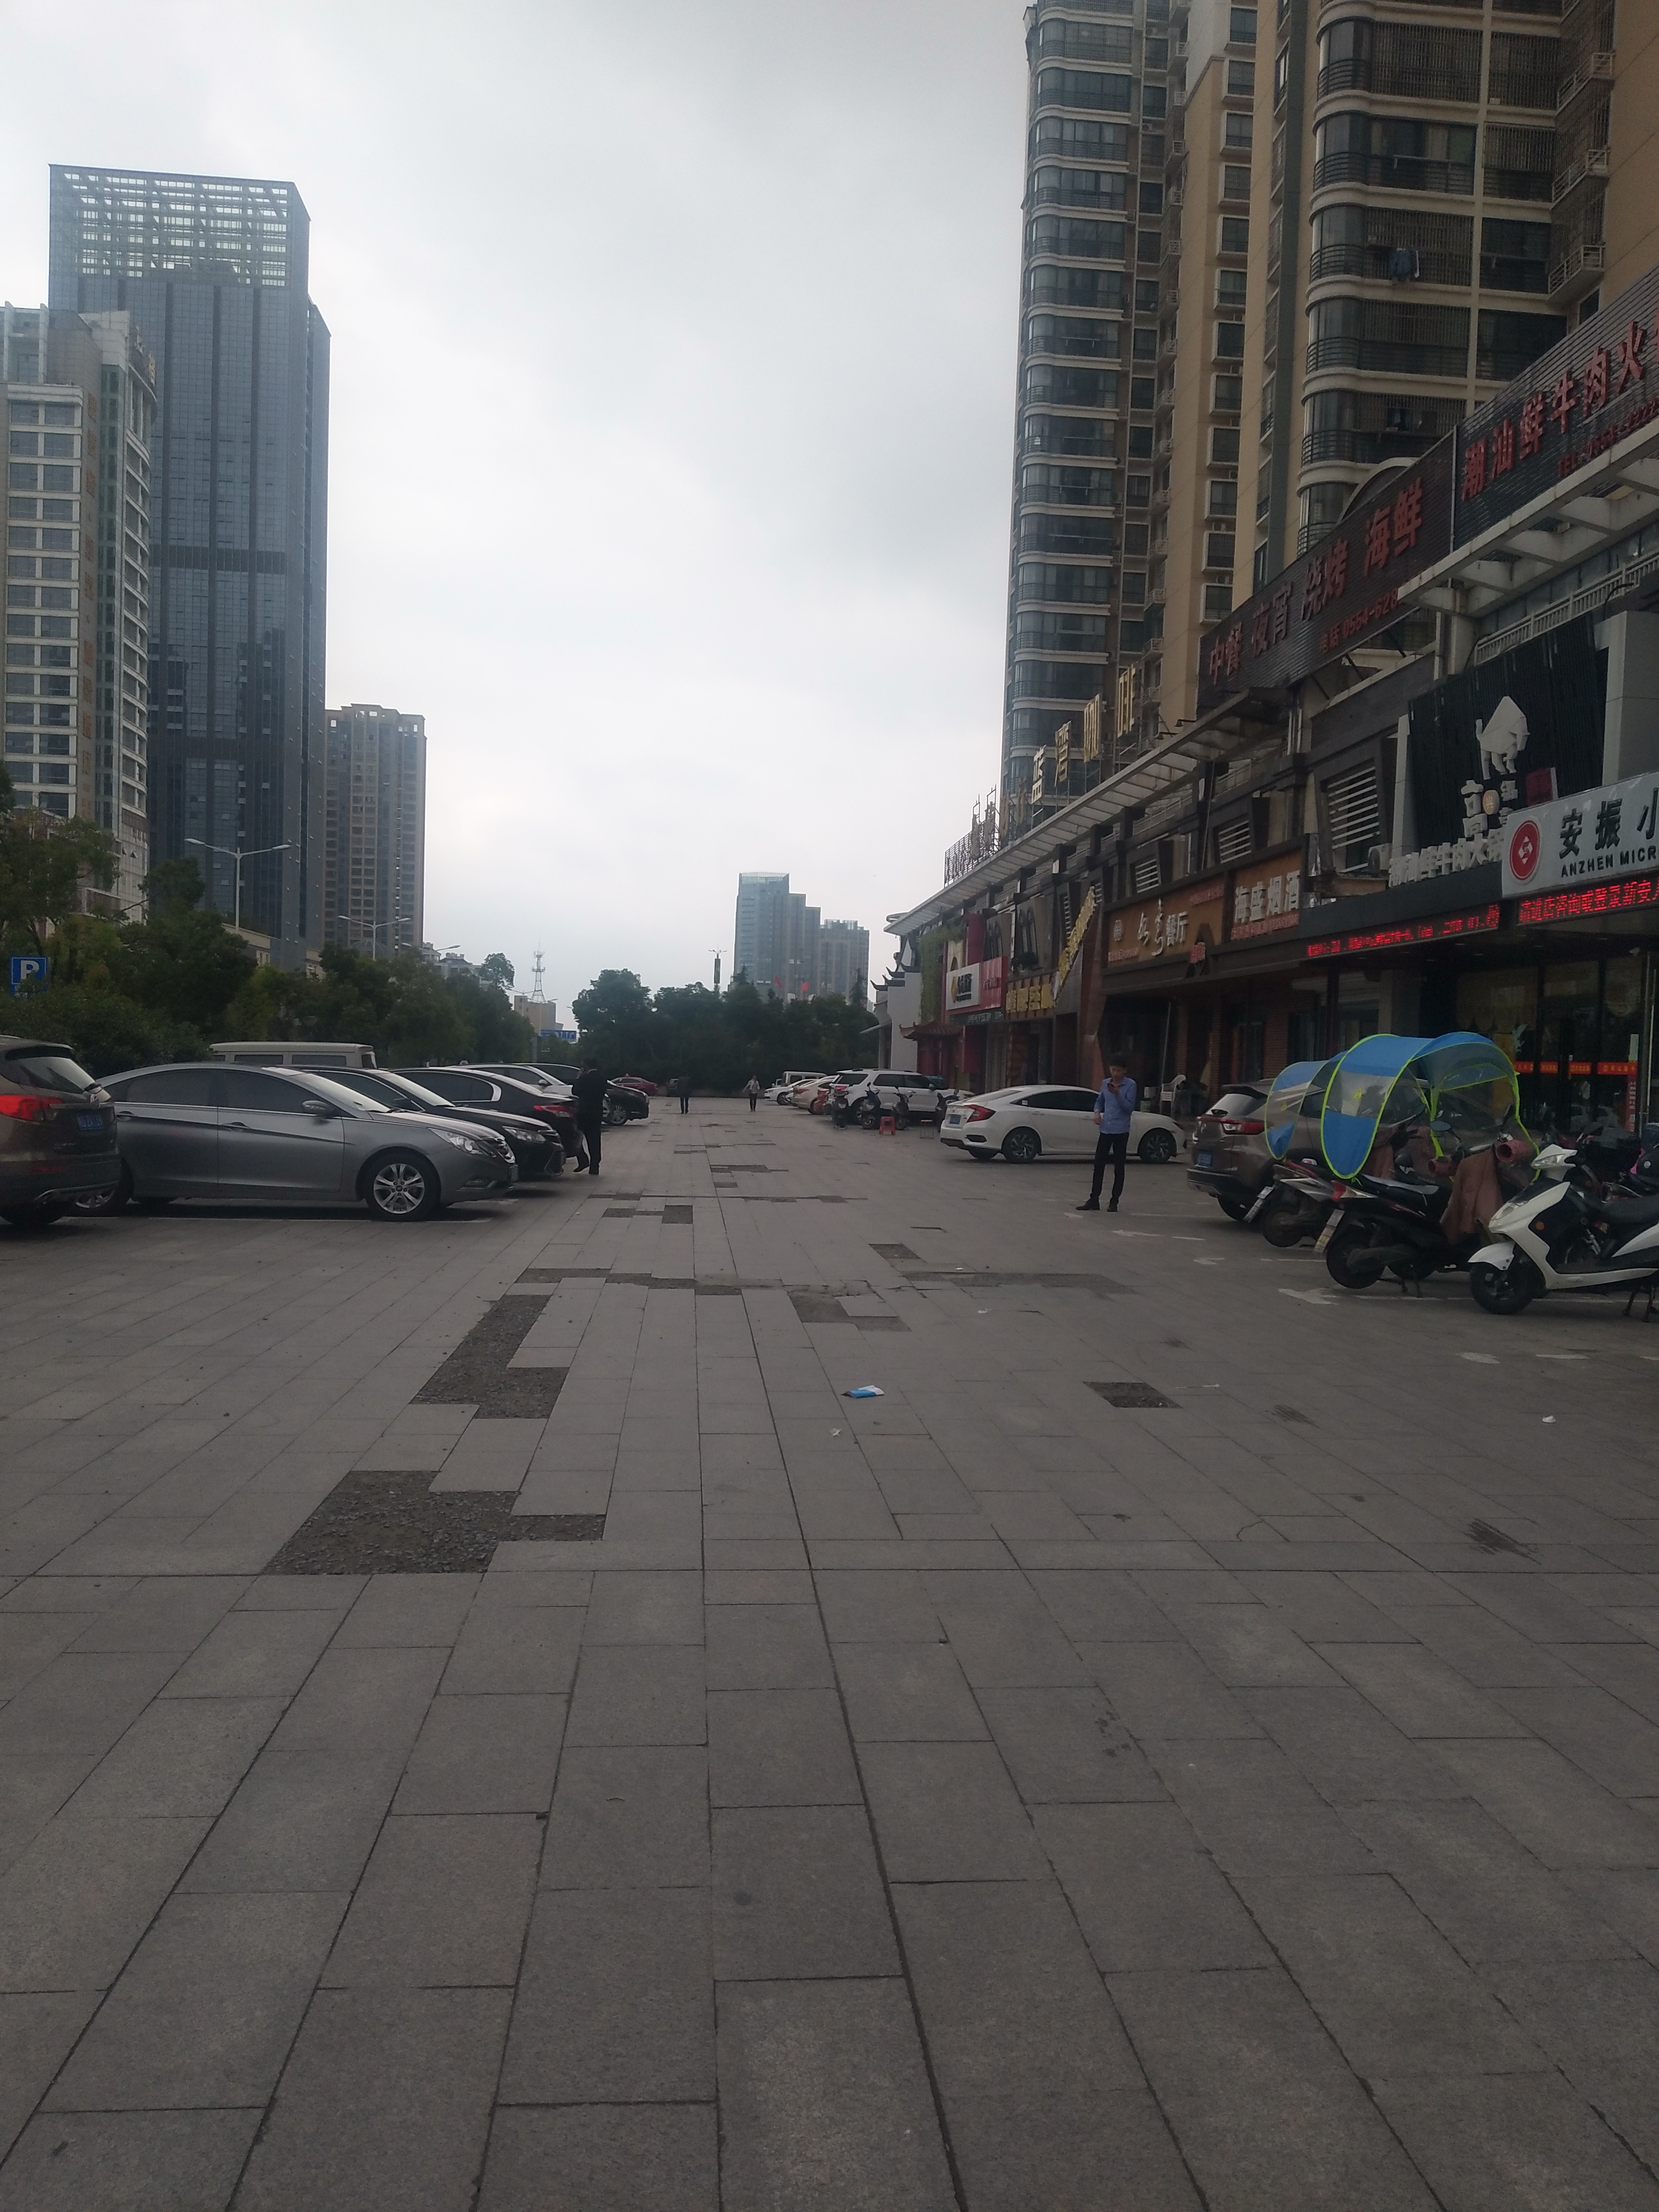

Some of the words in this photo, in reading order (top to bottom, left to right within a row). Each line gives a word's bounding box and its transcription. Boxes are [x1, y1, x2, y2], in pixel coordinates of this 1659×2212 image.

[1462, 301, 1659, 502] 潮汕鲜牛肉火
[1209, 622, 1242, 685] 中餐
[1251, 582, 1292, 657] 夜宵
[1301, 538, 1347, 621] 烧烤
[1364, 477, 1422, 577] 海鲜
[1559, 787, 1659, 859] 安振小
[1561, 854, 1613, 878] ANZHEN
[1620, 845, 1656, 866] MICR
[1234, 869, 1300, 924] 海盛烟酒
[21, 960, 40, 980] P
